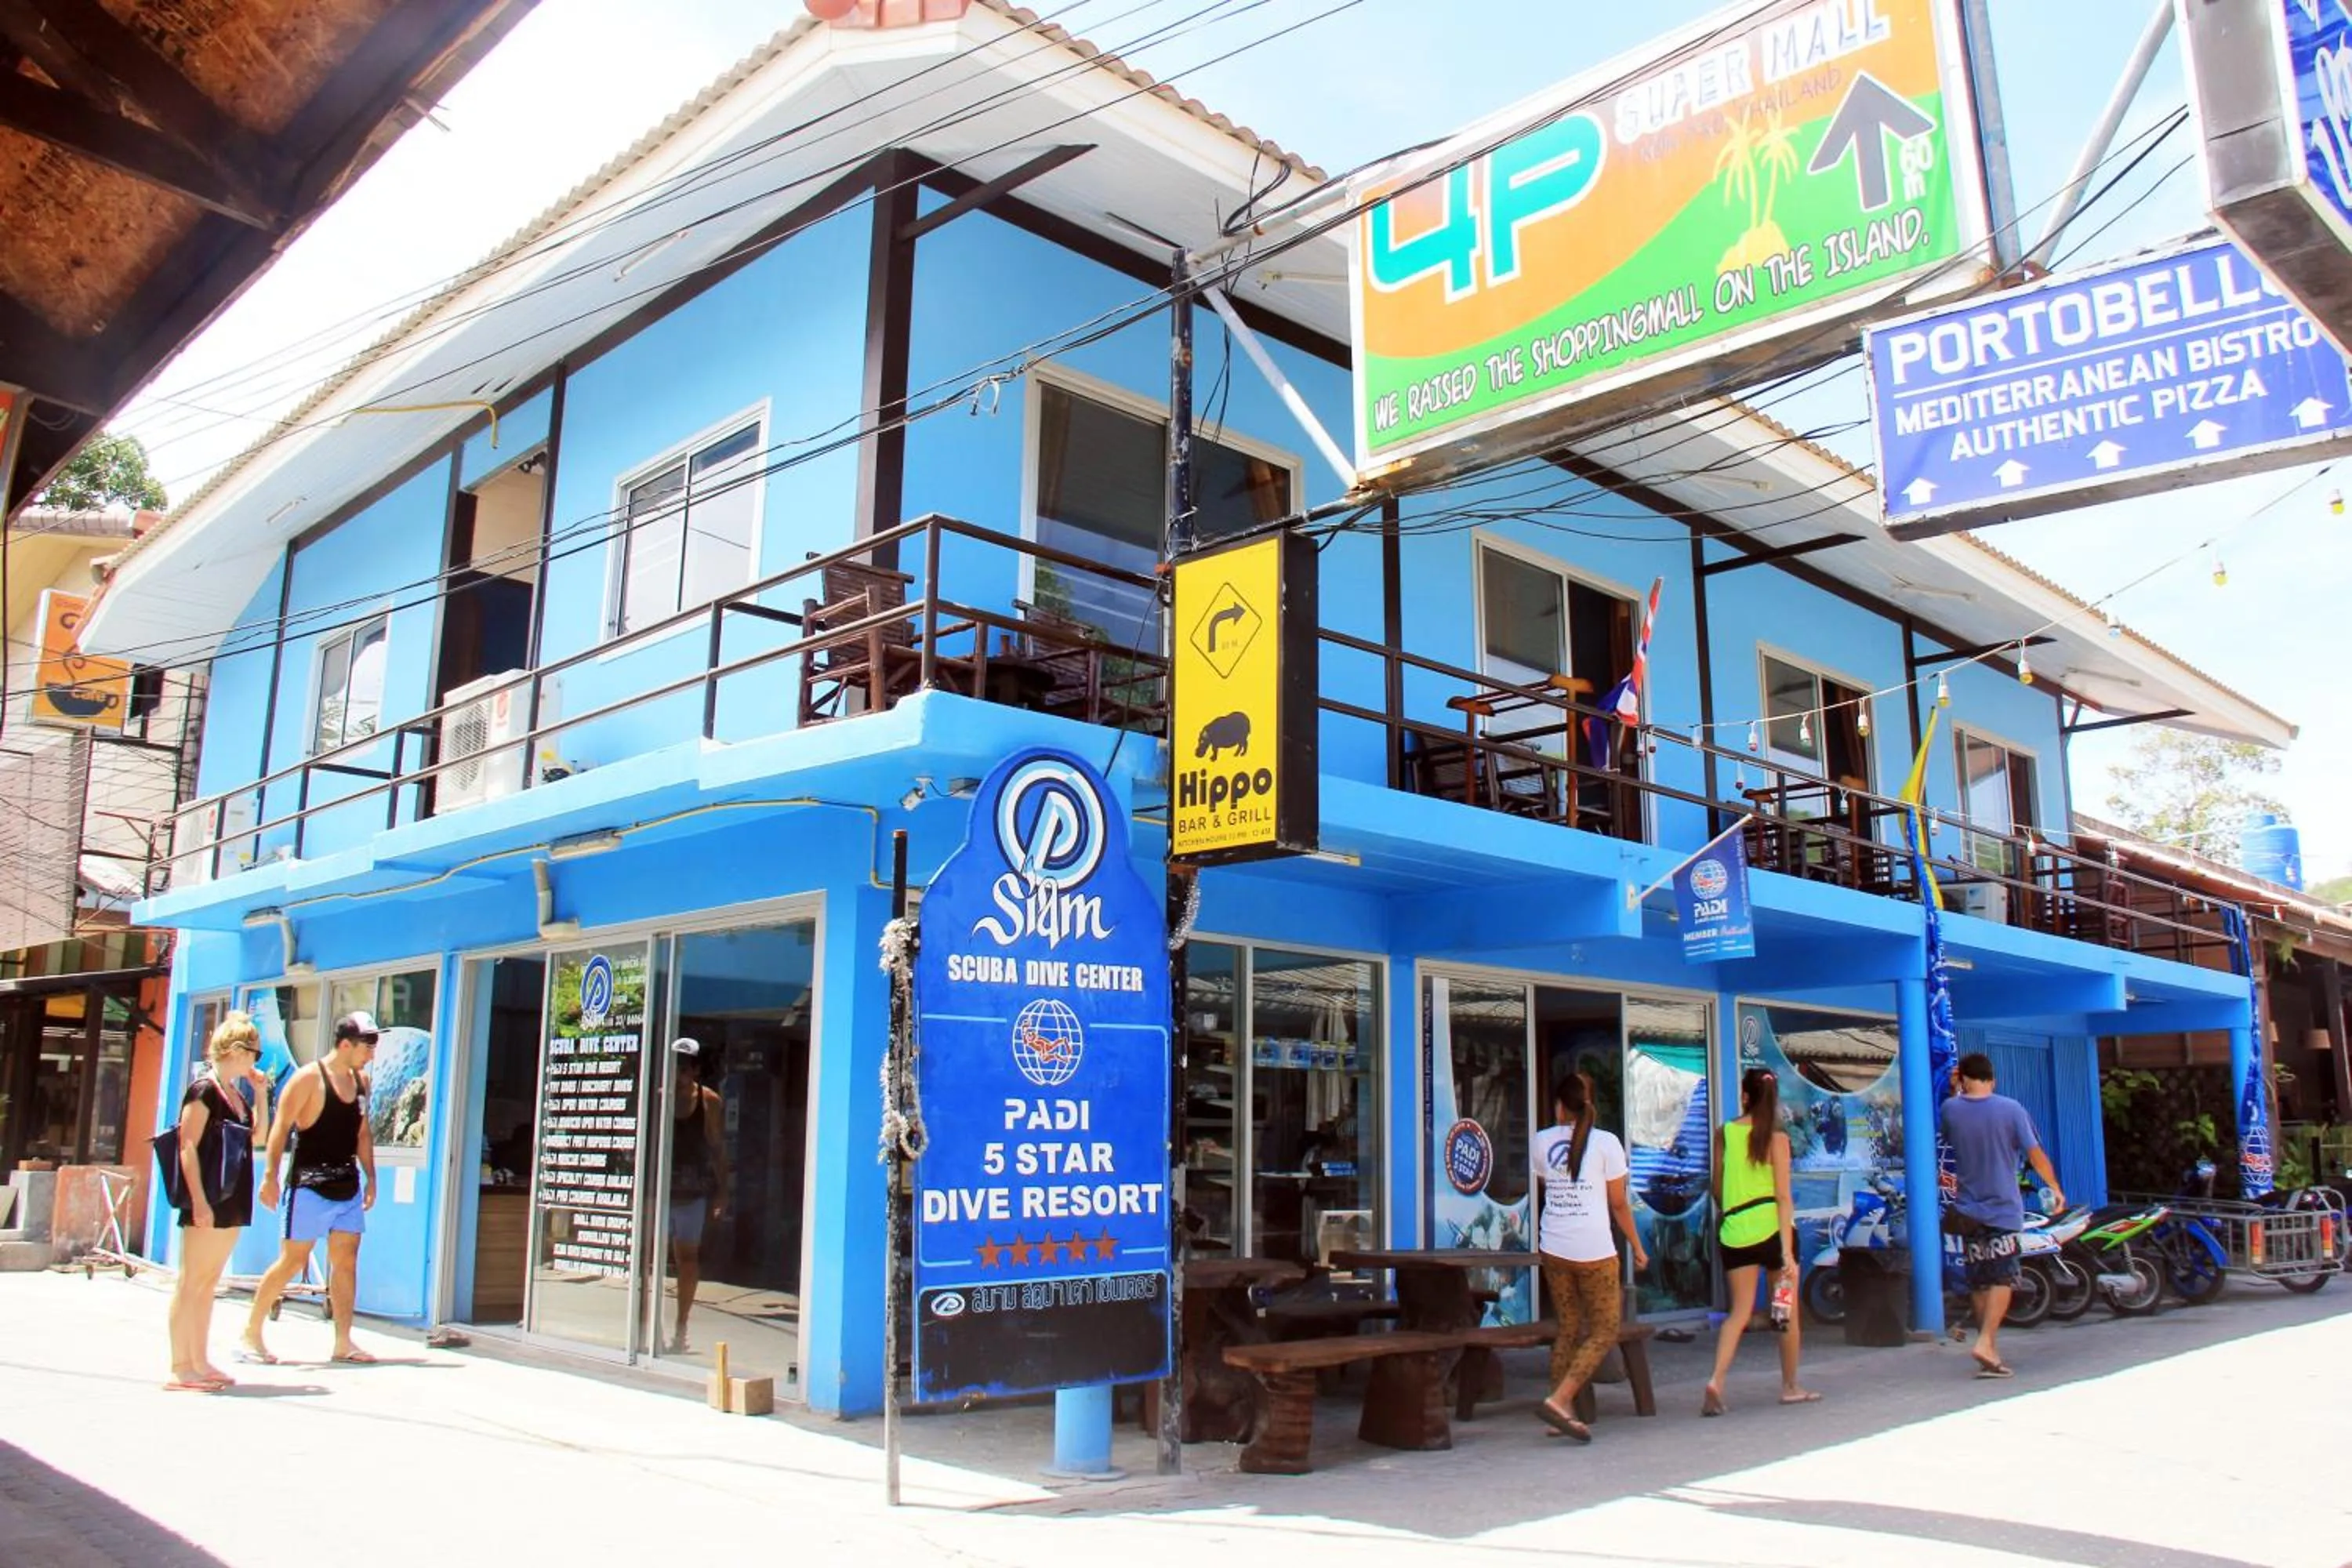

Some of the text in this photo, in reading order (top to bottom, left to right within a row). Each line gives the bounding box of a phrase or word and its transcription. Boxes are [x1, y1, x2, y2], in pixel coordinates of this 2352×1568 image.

[1616, 0, 1890, 143] SUPER MALL
[1898, 136, 1934, 173] 60
[1367, 111, 1606, 303] 4P
[1374, 207, 1929, 434] WE RAISED THE SHOPPINGMALL ON THE ISLAND.
[1895, 316, 2321, 435] MEDITERRANEAN BISTRO
[1951, 368, 2269, 461] AUTHENTIC PIZZA
[1178, 767, 1272, 813] Hippo
[1178, 808, 1272, 833] BAR & GRILL
[971, 861, 1116, 950] Siam
[1693, 898, 1729, 918] PADI
[948, 954, 1143, 992] SCUBA DIVE CENTER
[1004, 1099, 1089, 1131] PADI
[984, 1142, 1114, 1175] 5 STAR
[1455, 1137, 1481, 1165] PADI
[923, 1184, 1163, 1223] DIVE RESORT
